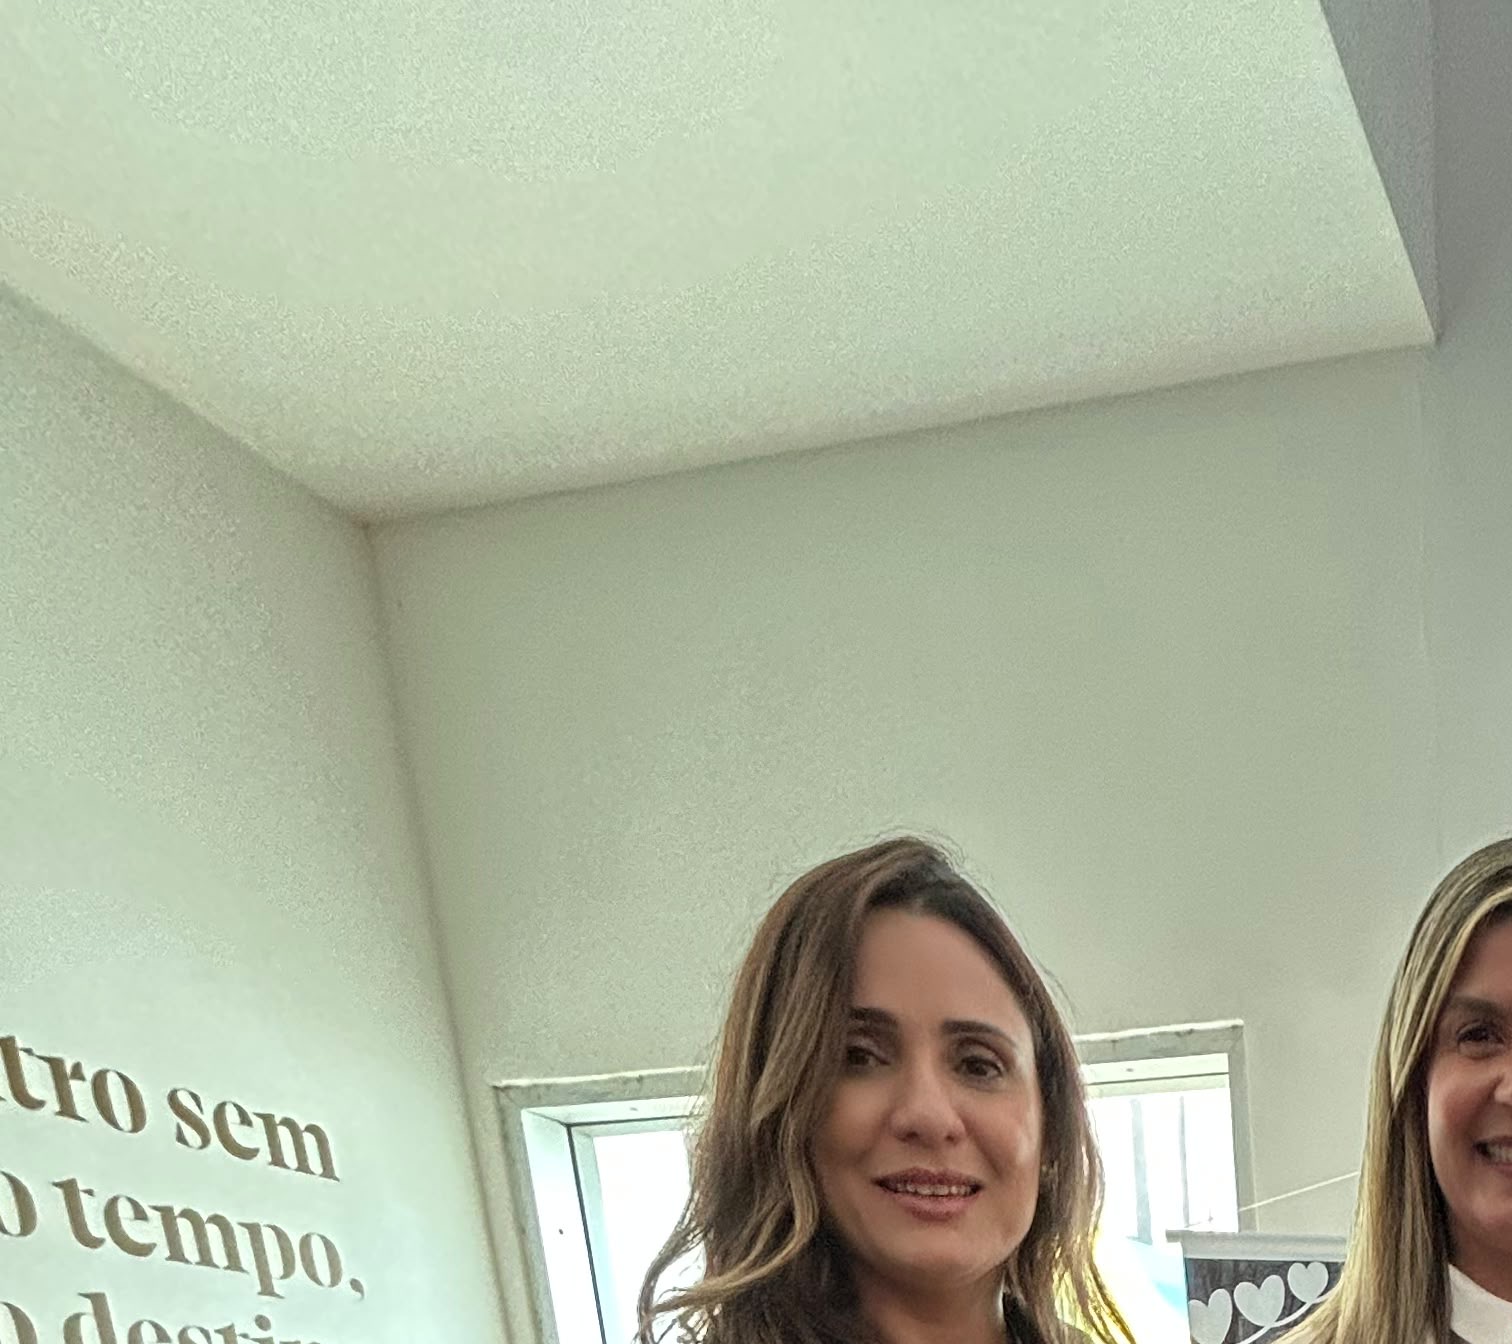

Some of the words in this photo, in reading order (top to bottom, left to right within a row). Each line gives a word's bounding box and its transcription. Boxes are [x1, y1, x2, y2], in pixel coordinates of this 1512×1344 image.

[0, 1035, 146, 1134] tro
[167, 1088, 340, 1182] sem
[51, 1175, 365, 1301] tempo,
